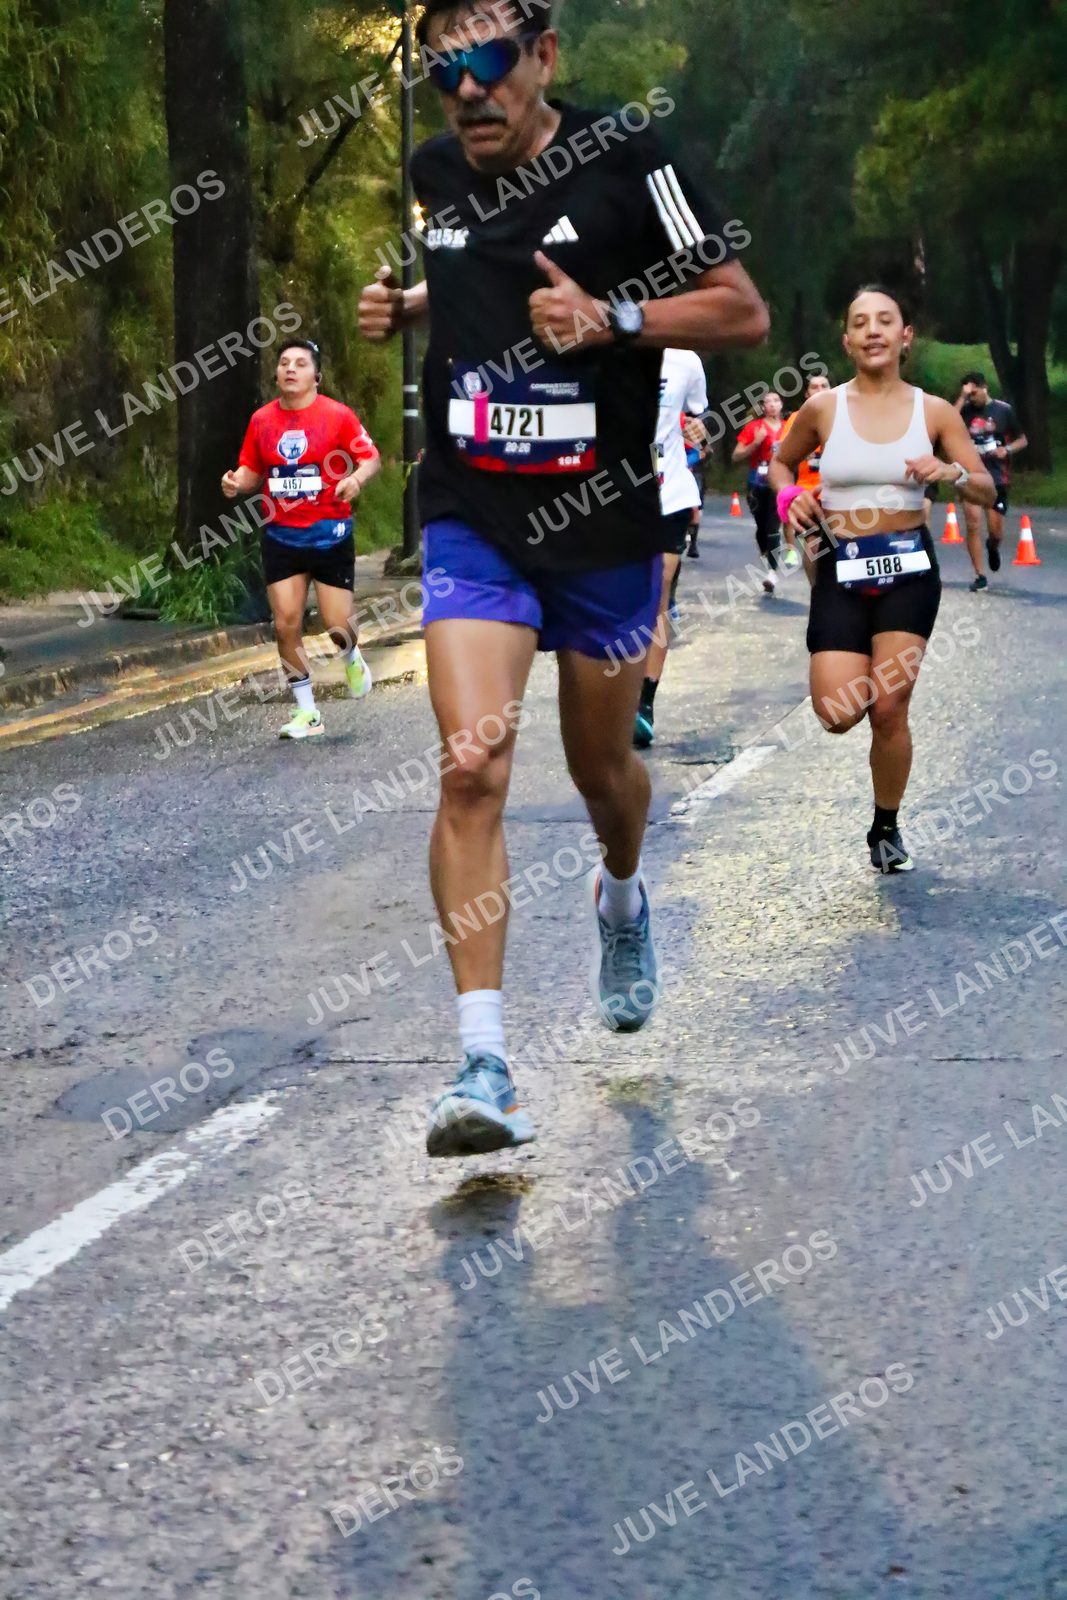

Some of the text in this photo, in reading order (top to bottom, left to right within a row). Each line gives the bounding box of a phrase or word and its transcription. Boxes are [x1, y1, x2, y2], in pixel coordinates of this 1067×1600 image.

[490, 406, 544, 436] 4721
[282, 479, 302, 490] 4157
[866, 556, 903, 576] 5188
